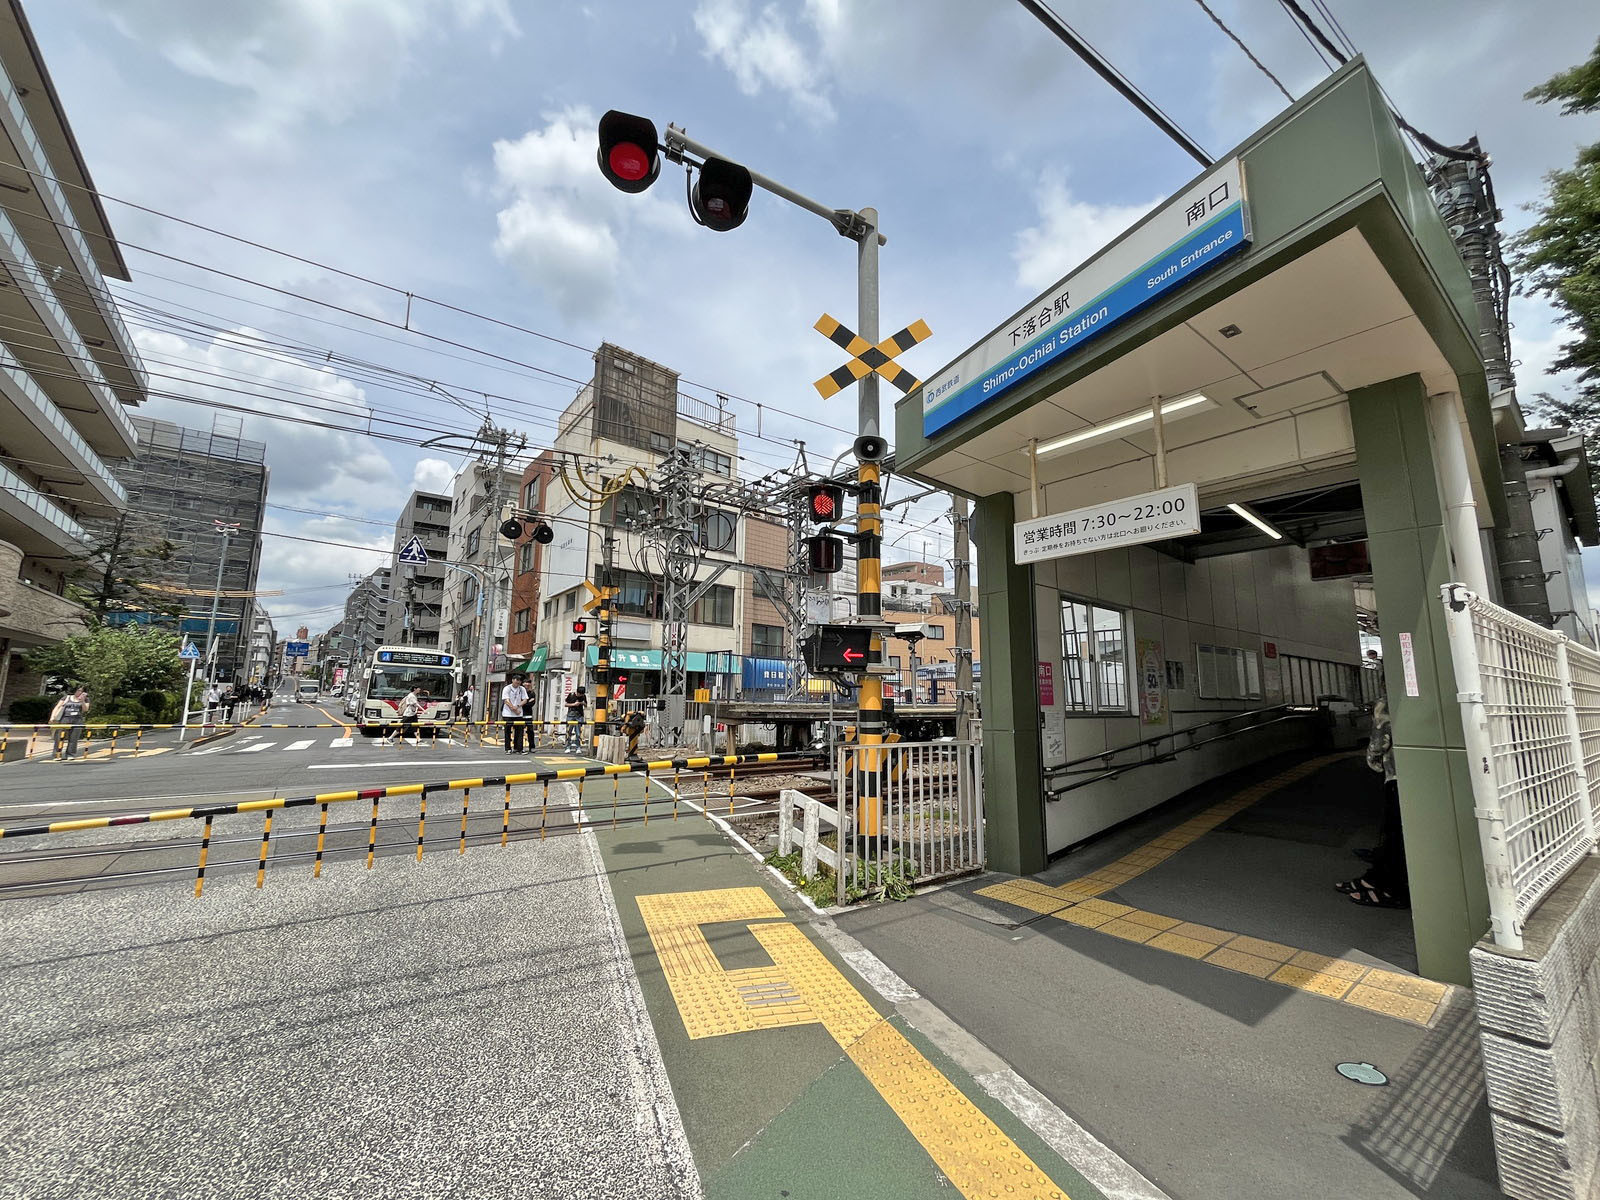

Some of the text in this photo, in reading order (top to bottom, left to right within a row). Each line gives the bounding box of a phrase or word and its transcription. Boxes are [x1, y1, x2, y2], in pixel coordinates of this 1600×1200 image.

[1185, 181, 1229, 226] 南口
[1147, 229, 1233, 289] South Entrance
[1008, 291, 1070, 347] 下落合駅
[983, 306, 1108, 393] Shimo-Ochiai Station
[935, 374, 960, 398] 西武鉄道
[1023, 520, 1077, 545] 営業時間
